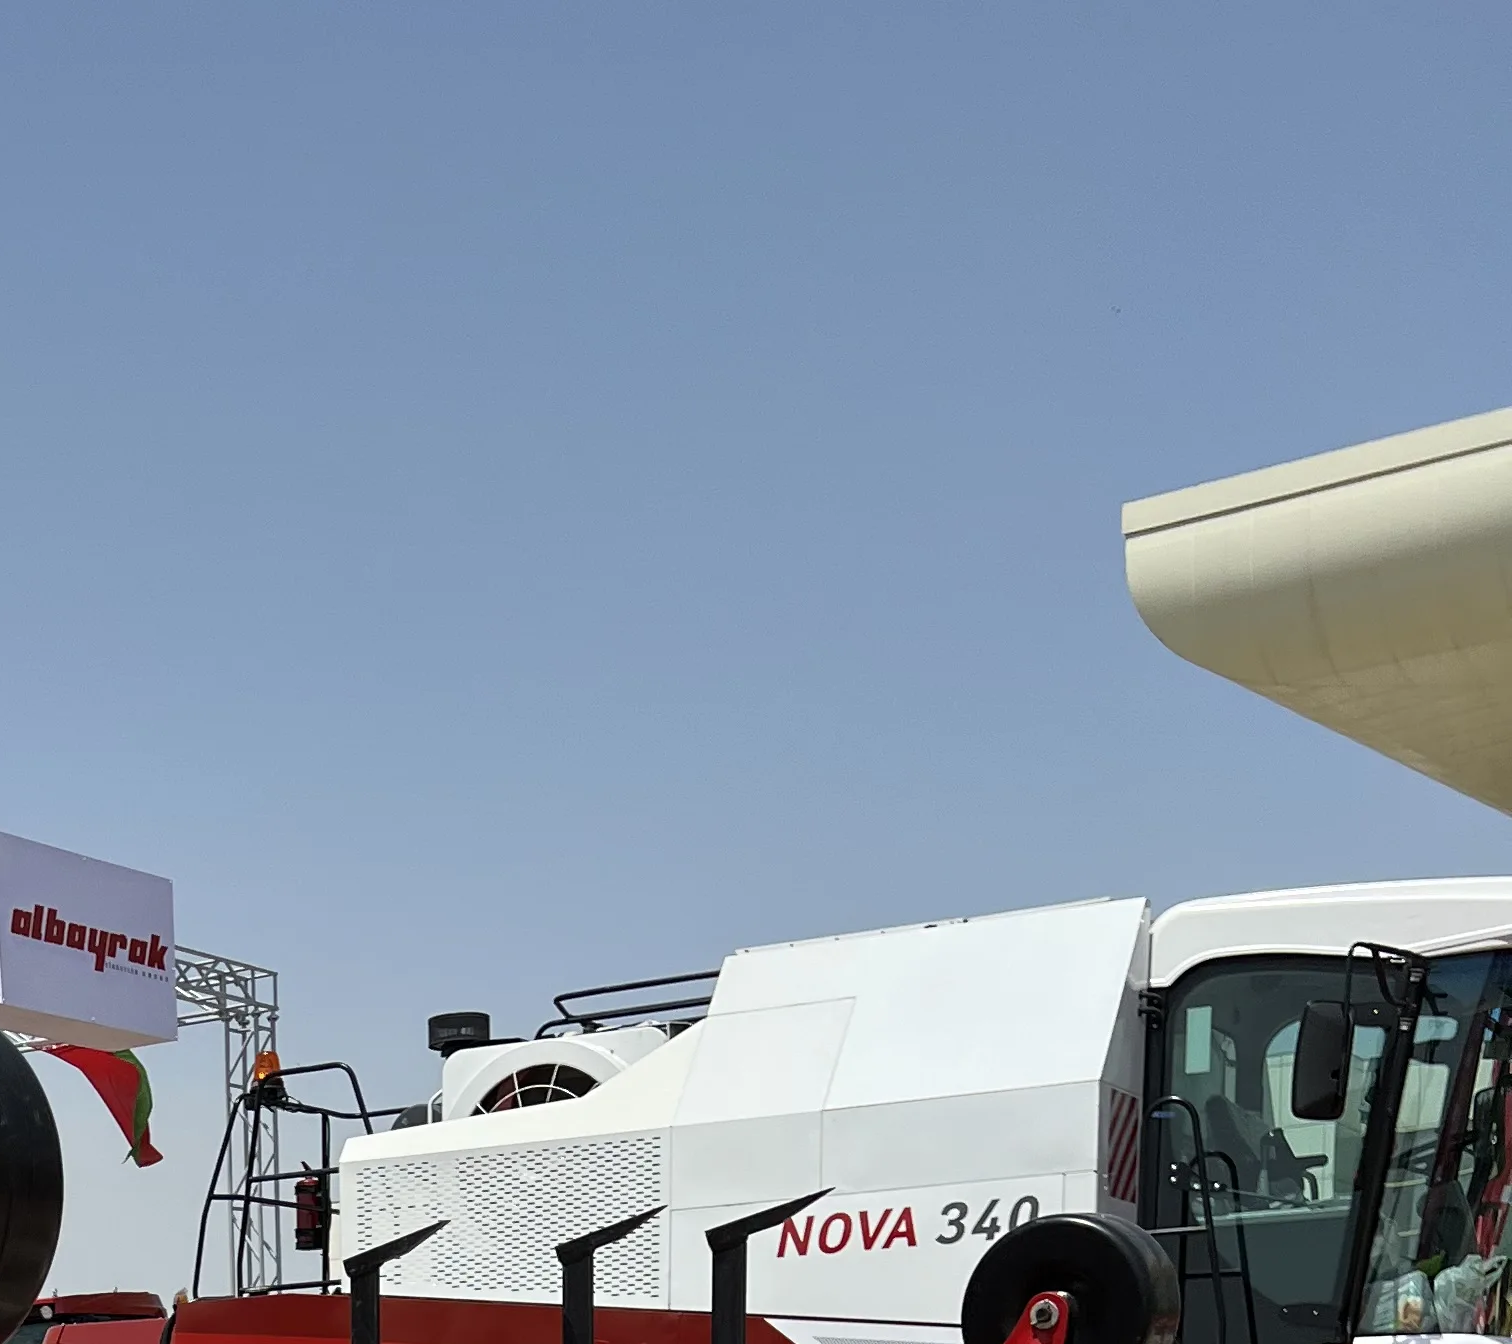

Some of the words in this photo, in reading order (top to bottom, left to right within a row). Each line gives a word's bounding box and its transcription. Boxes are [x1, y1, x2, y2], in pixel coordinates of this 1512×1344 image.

[11, 904, 168, 972] albayrak
[777, 1206, 917, 1258] NOVA
[935, 1195, 1040, 1245] 340
